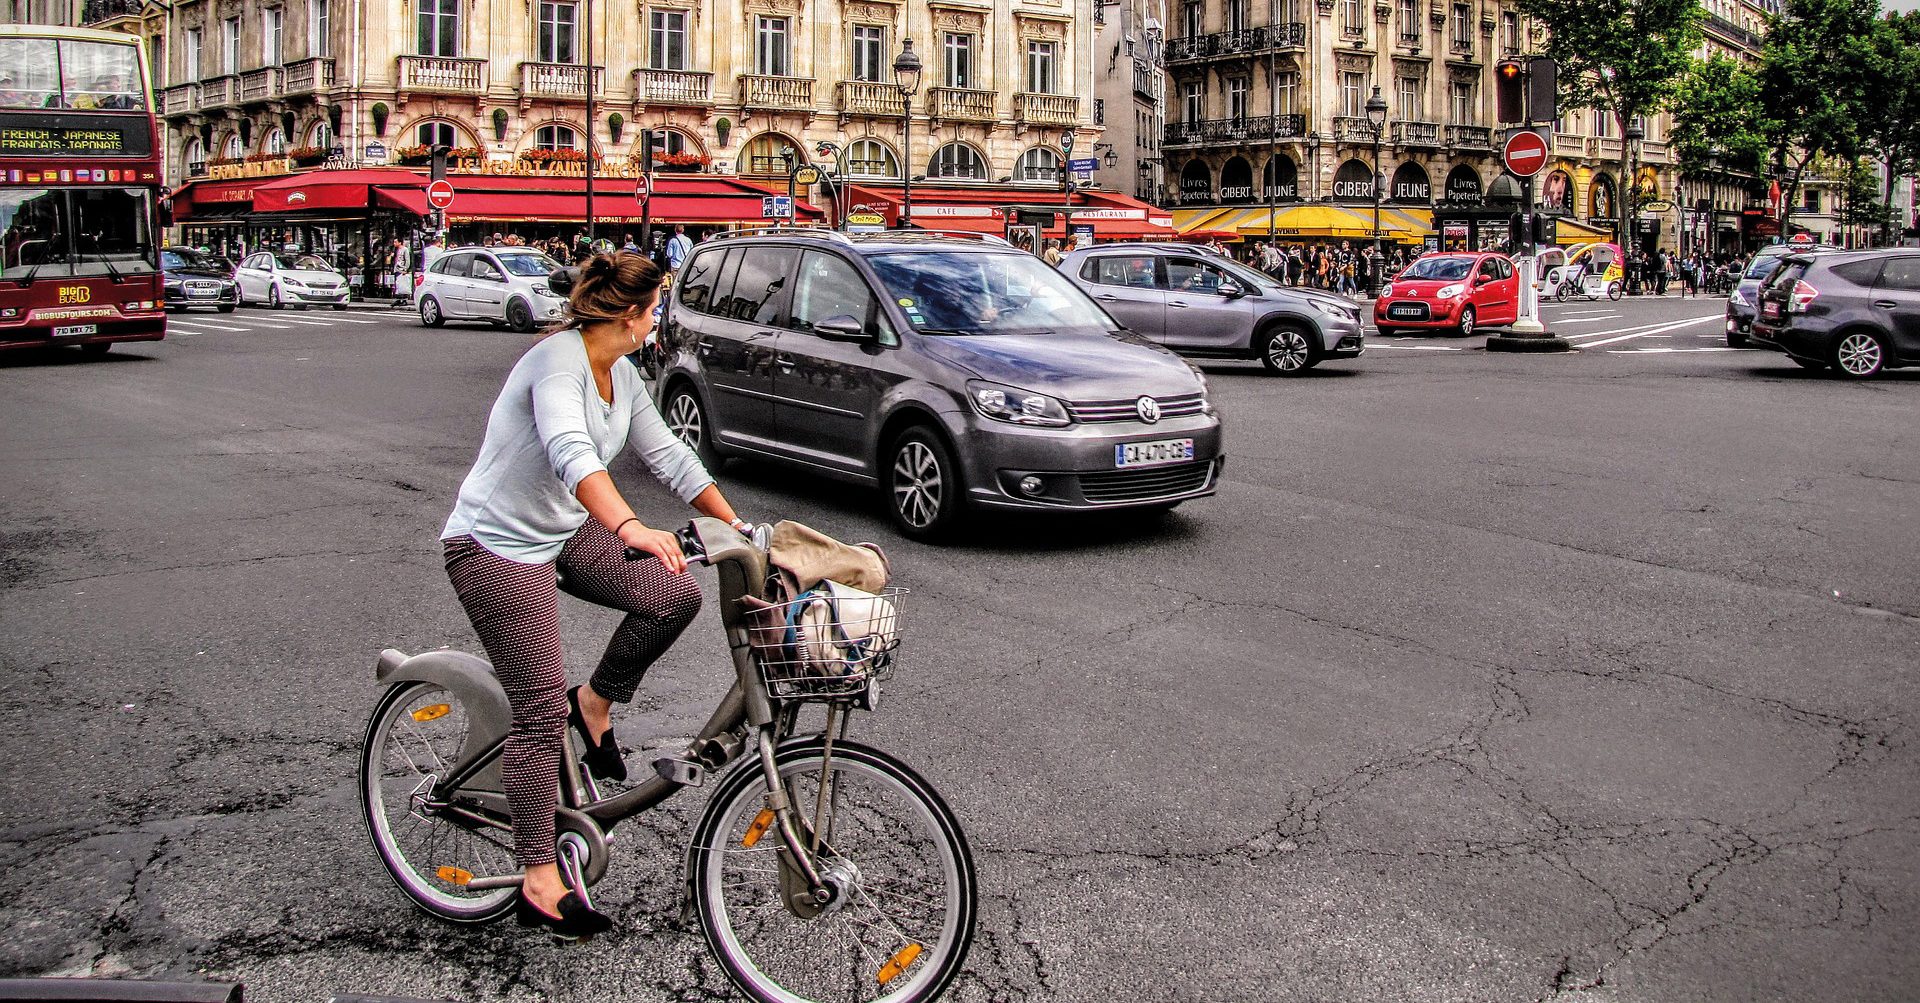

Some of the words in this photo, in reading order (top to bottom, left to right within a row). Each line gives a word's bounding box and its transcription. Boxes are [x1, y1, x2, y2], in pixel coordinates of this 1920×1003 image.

[2, 130, 49, 140] FRENCH
[62, 131, 121, 140] JAPANESE
[1062, 136, 1070, 144] BUS
[321, 160, 359, 171] LAVAZZA
[457, 158, 475, 174] LE
[481, 159, 542, 177] DEPART
[545, 160, 587, 177] SAINT
[600, 162, 641, 178] MICH
[1182, 178, 1208, 188] Livres
[1453, 178, 1477, 189] Livres
[1180, 189, 1210, 201] Papeterie
[1220, 186, 1251, 198] GIBERT
[1334, 181, 1374, 197] GIBERT
[1395, 183, 1429, 198] JEUNE
[1448, 189, 1481, 202] Papeterie
[60, 287, 77, 296] BIG
[59, 296, 77, 304] BUS
[35, 309, 111, 320] BIGBUSTOURS.COM
